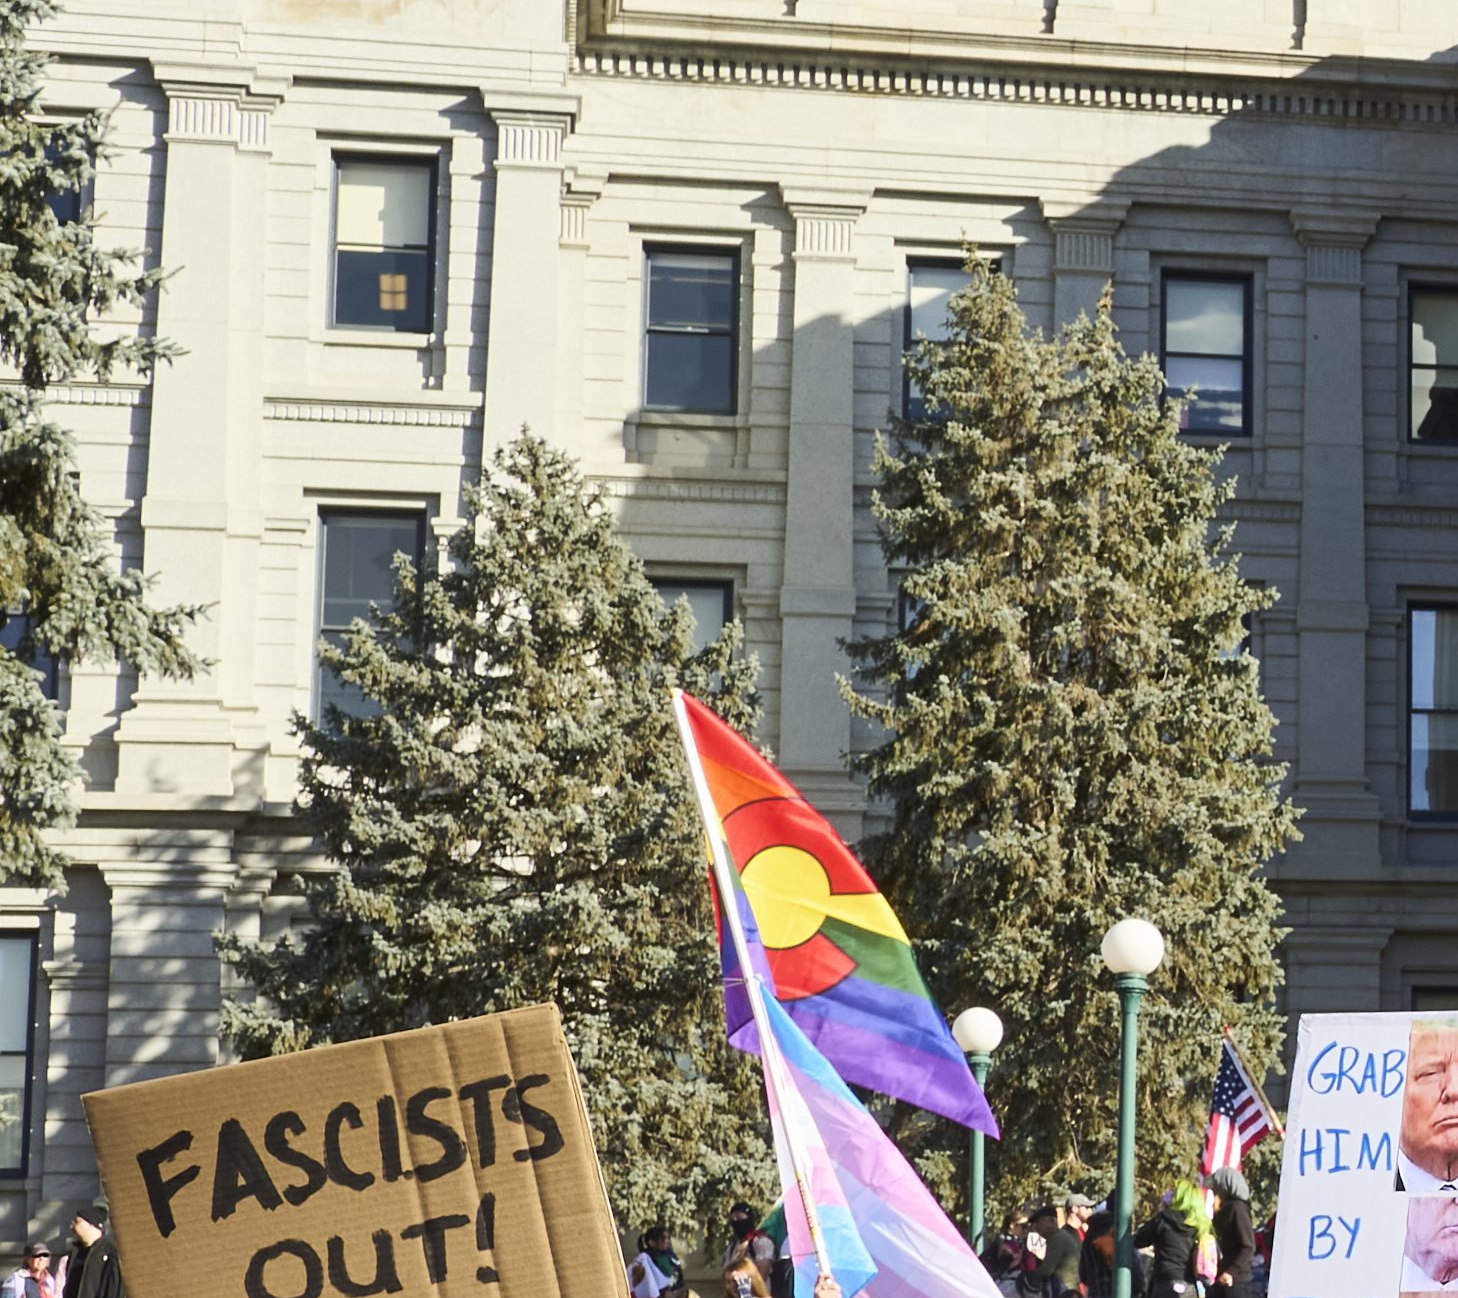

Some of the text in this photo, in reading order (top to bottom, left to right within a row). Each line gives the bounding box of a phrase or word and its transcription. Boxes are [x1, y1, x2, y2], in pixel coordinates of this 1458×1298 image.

[1307, 1040, 1406, 1099] GRAB
[137, 1073, 565, 1237] FASCISTS
[1299, 1128, 1393, 1177] HIM
[1308, 1214, 1361, 1262] BY
